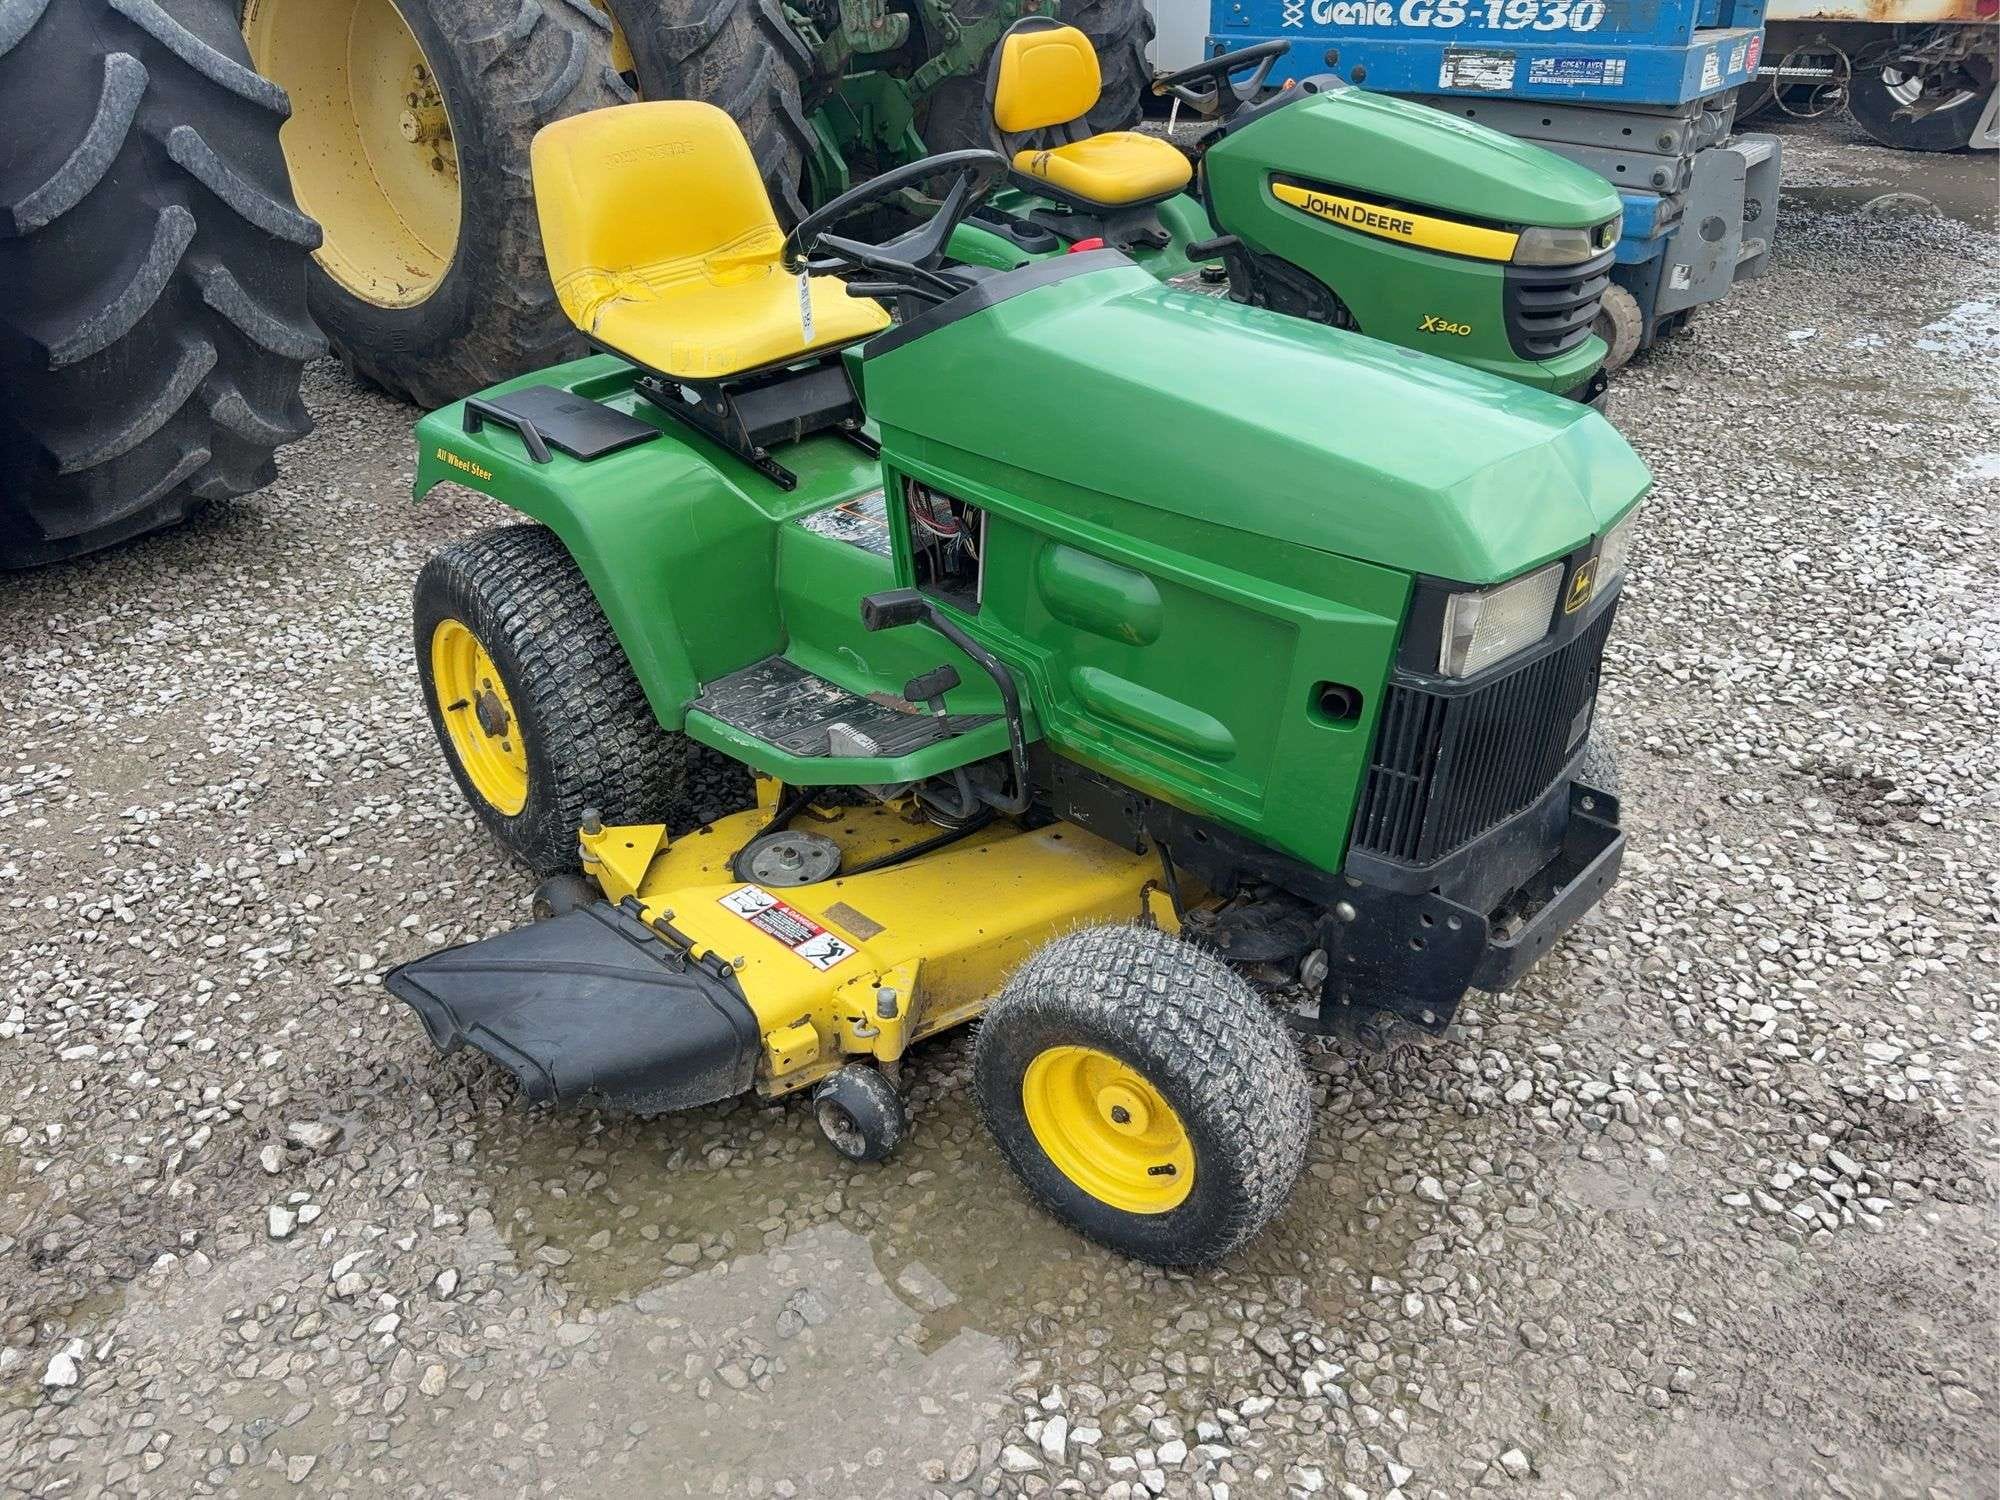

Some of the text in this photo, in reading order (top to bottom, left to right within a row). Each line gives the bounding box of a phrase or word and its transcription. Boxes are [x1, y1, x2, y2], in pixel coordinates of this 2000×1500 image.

[1311, 0, 1606, 32] Genie GS-1930
[1301, 194, 1414, 235] JOHN DEERE
[1418, 314, 1471, 336] X340
[436, 448, 493, 481] All Wheel Steer
